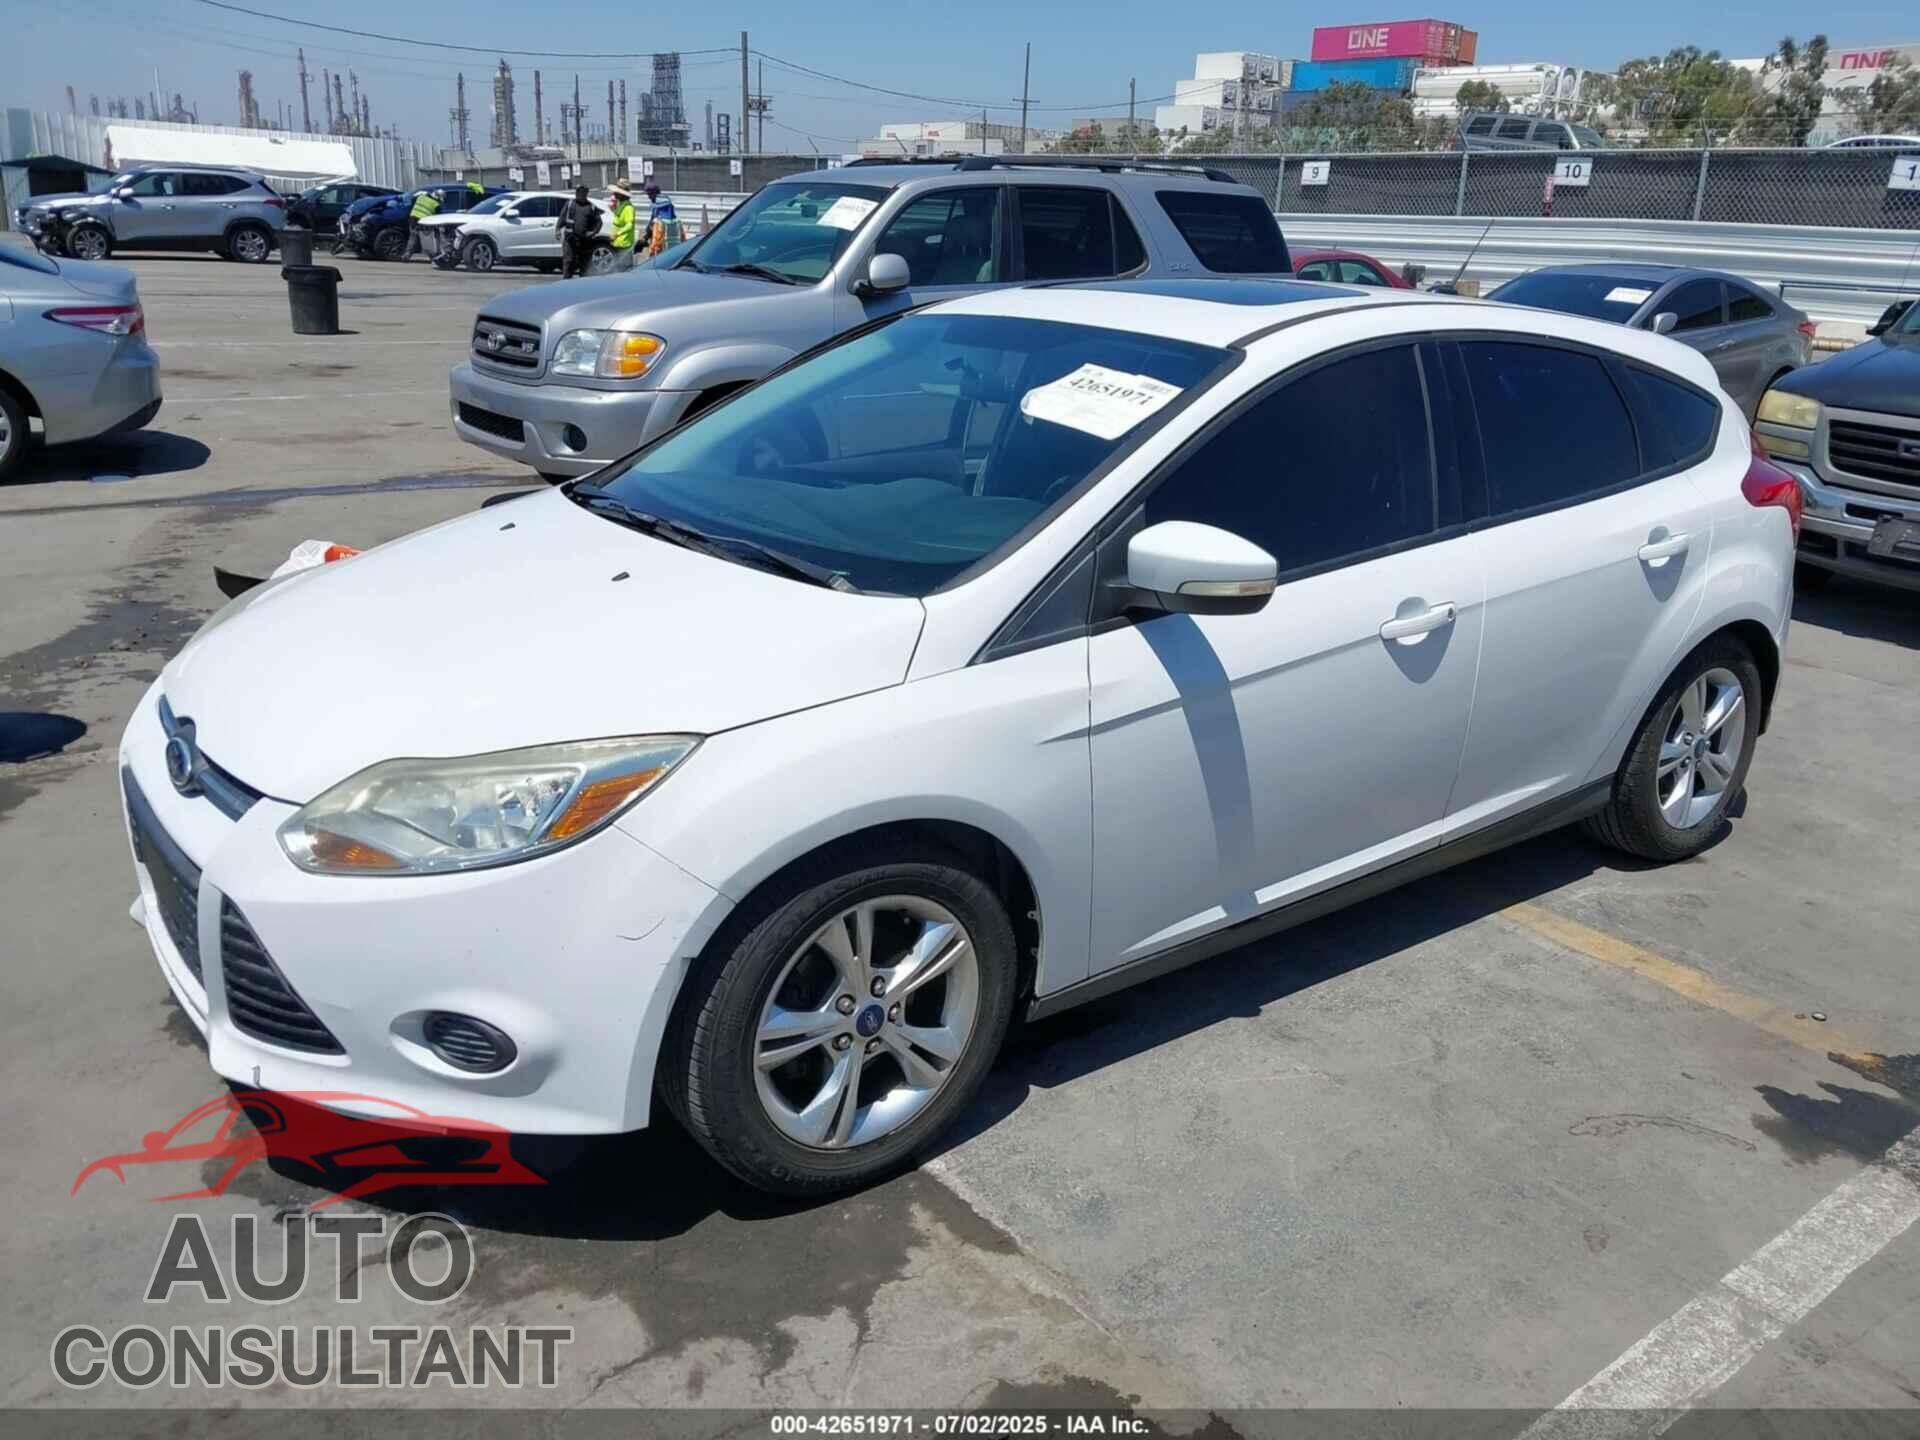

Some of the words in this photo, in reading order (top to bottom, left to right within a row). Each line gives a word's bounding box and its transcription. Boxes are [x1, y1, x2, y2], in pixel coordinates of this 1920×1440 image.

[1347, 28, 1389, 49] ONE
[1311, 166, 1320, 179] 9
[1564, 164, 1582, 178] 10
[1069, 377, 1154, 406] 42651971
